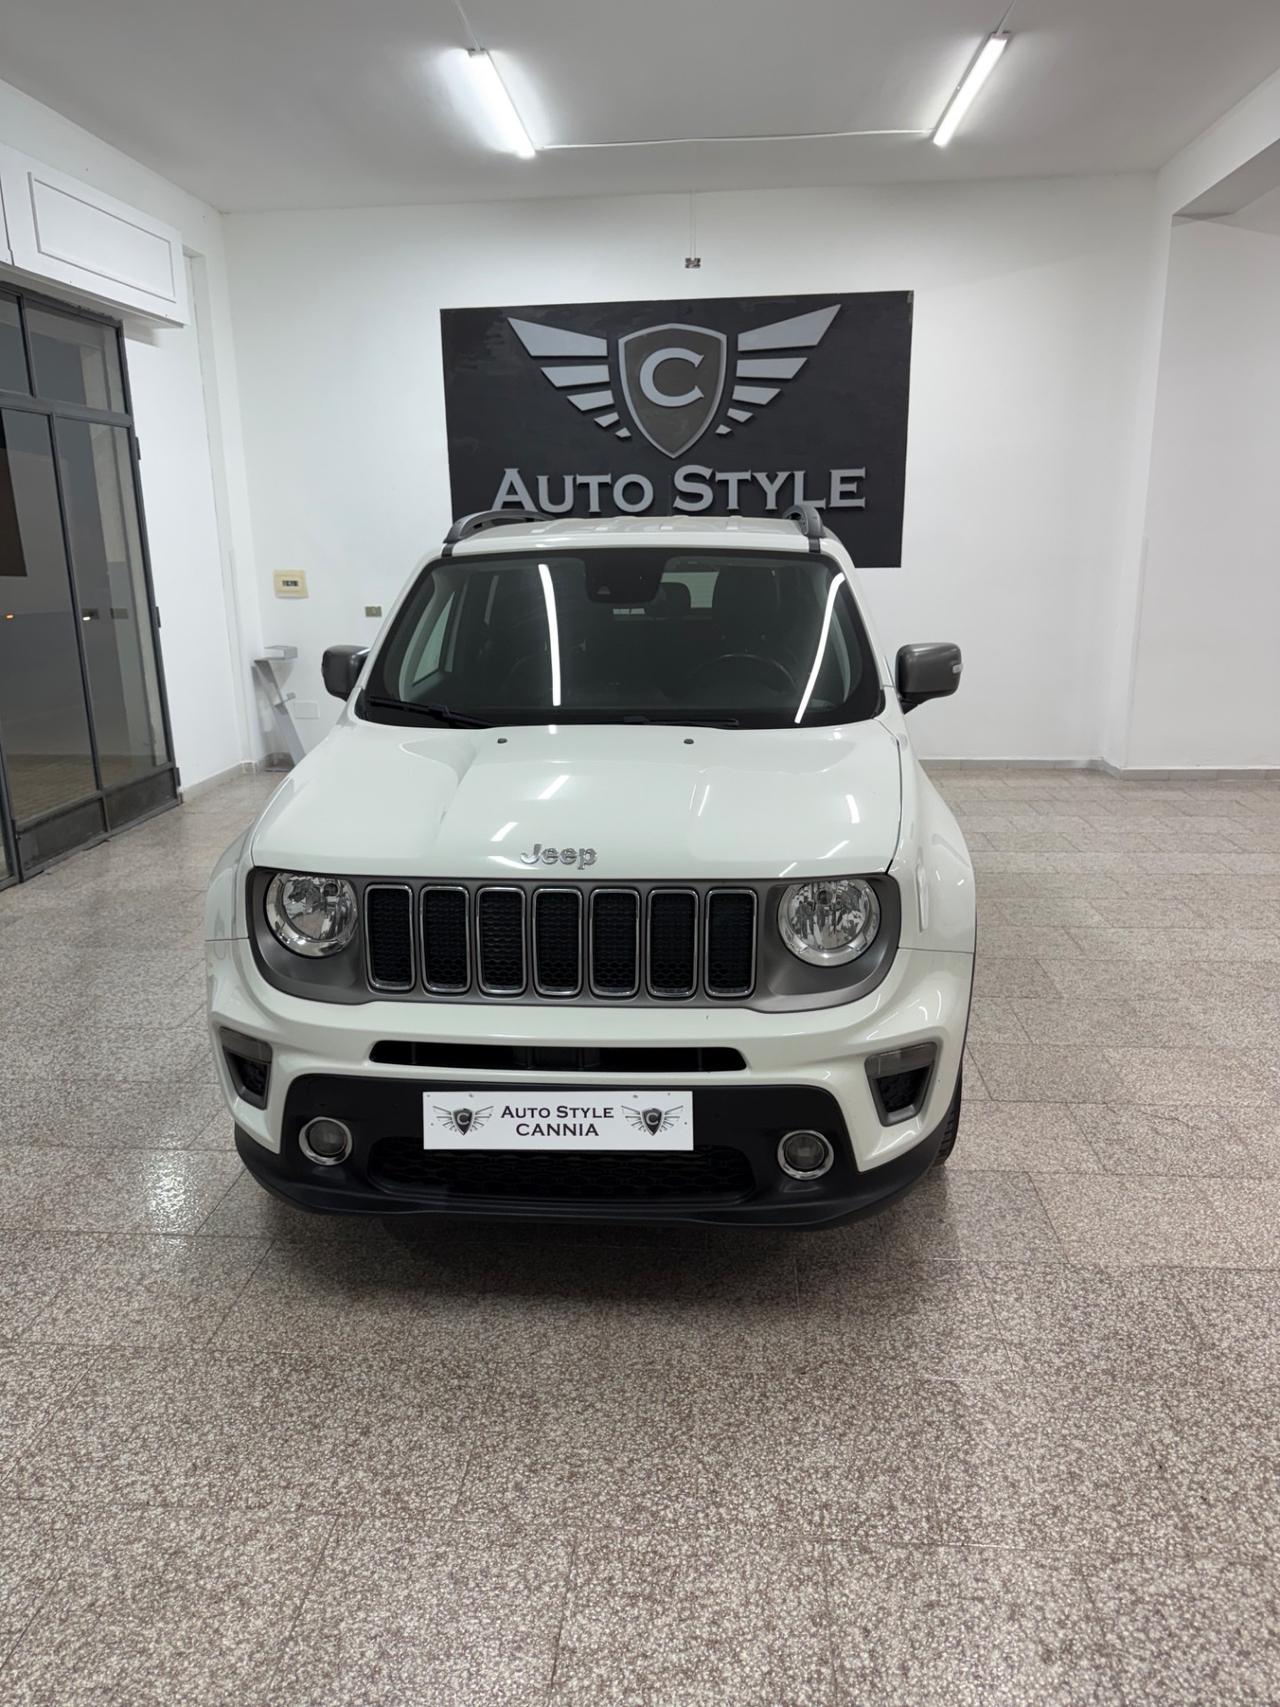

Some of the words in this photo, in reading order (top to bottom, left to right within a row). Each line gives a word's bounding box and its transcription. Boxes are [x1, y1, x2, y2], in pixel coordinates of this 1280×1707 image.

[639, 346, 705, 408] C
[491, 467, 654, 513] AUTO
[673, 464, 867, 510] STYLE
[520, 843, 597, 870] Jeep
[500, 1105, 551, 1119] AUTO
[556, 1105, 615, 1119] STYLE
[515, 1123, 600, 1137] CANNIA
